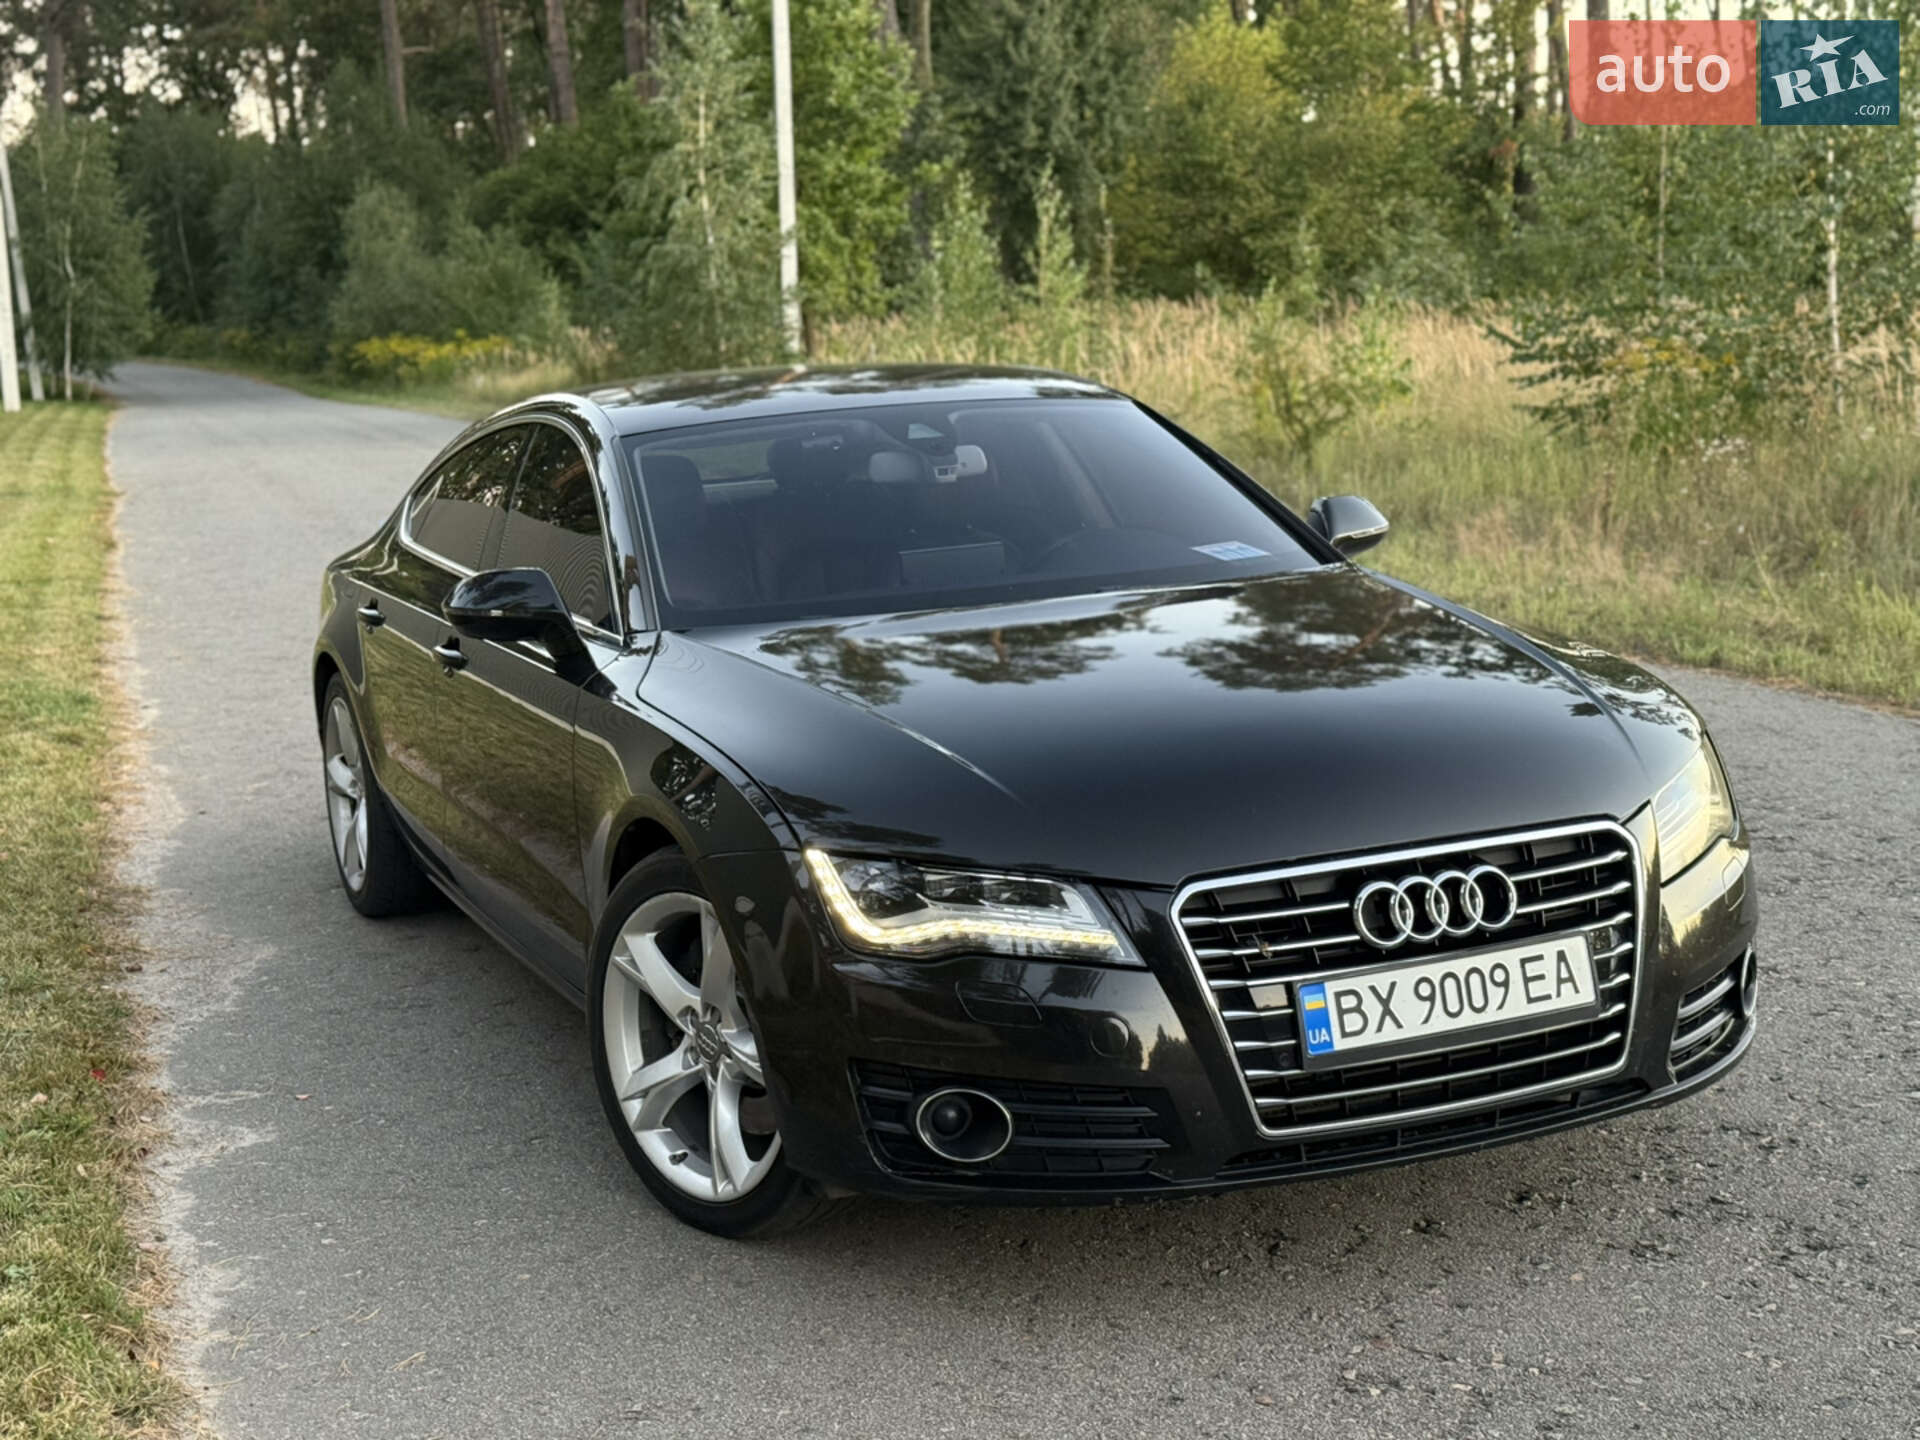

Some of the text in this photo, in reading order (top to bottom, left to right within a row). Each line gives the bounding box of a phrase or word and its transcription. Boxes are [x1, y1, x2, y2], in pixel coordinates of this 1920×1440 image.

[1333, 949, 1581, 1039] BX 9009 EA
[1308, 1027, 1331, 1045] UA
